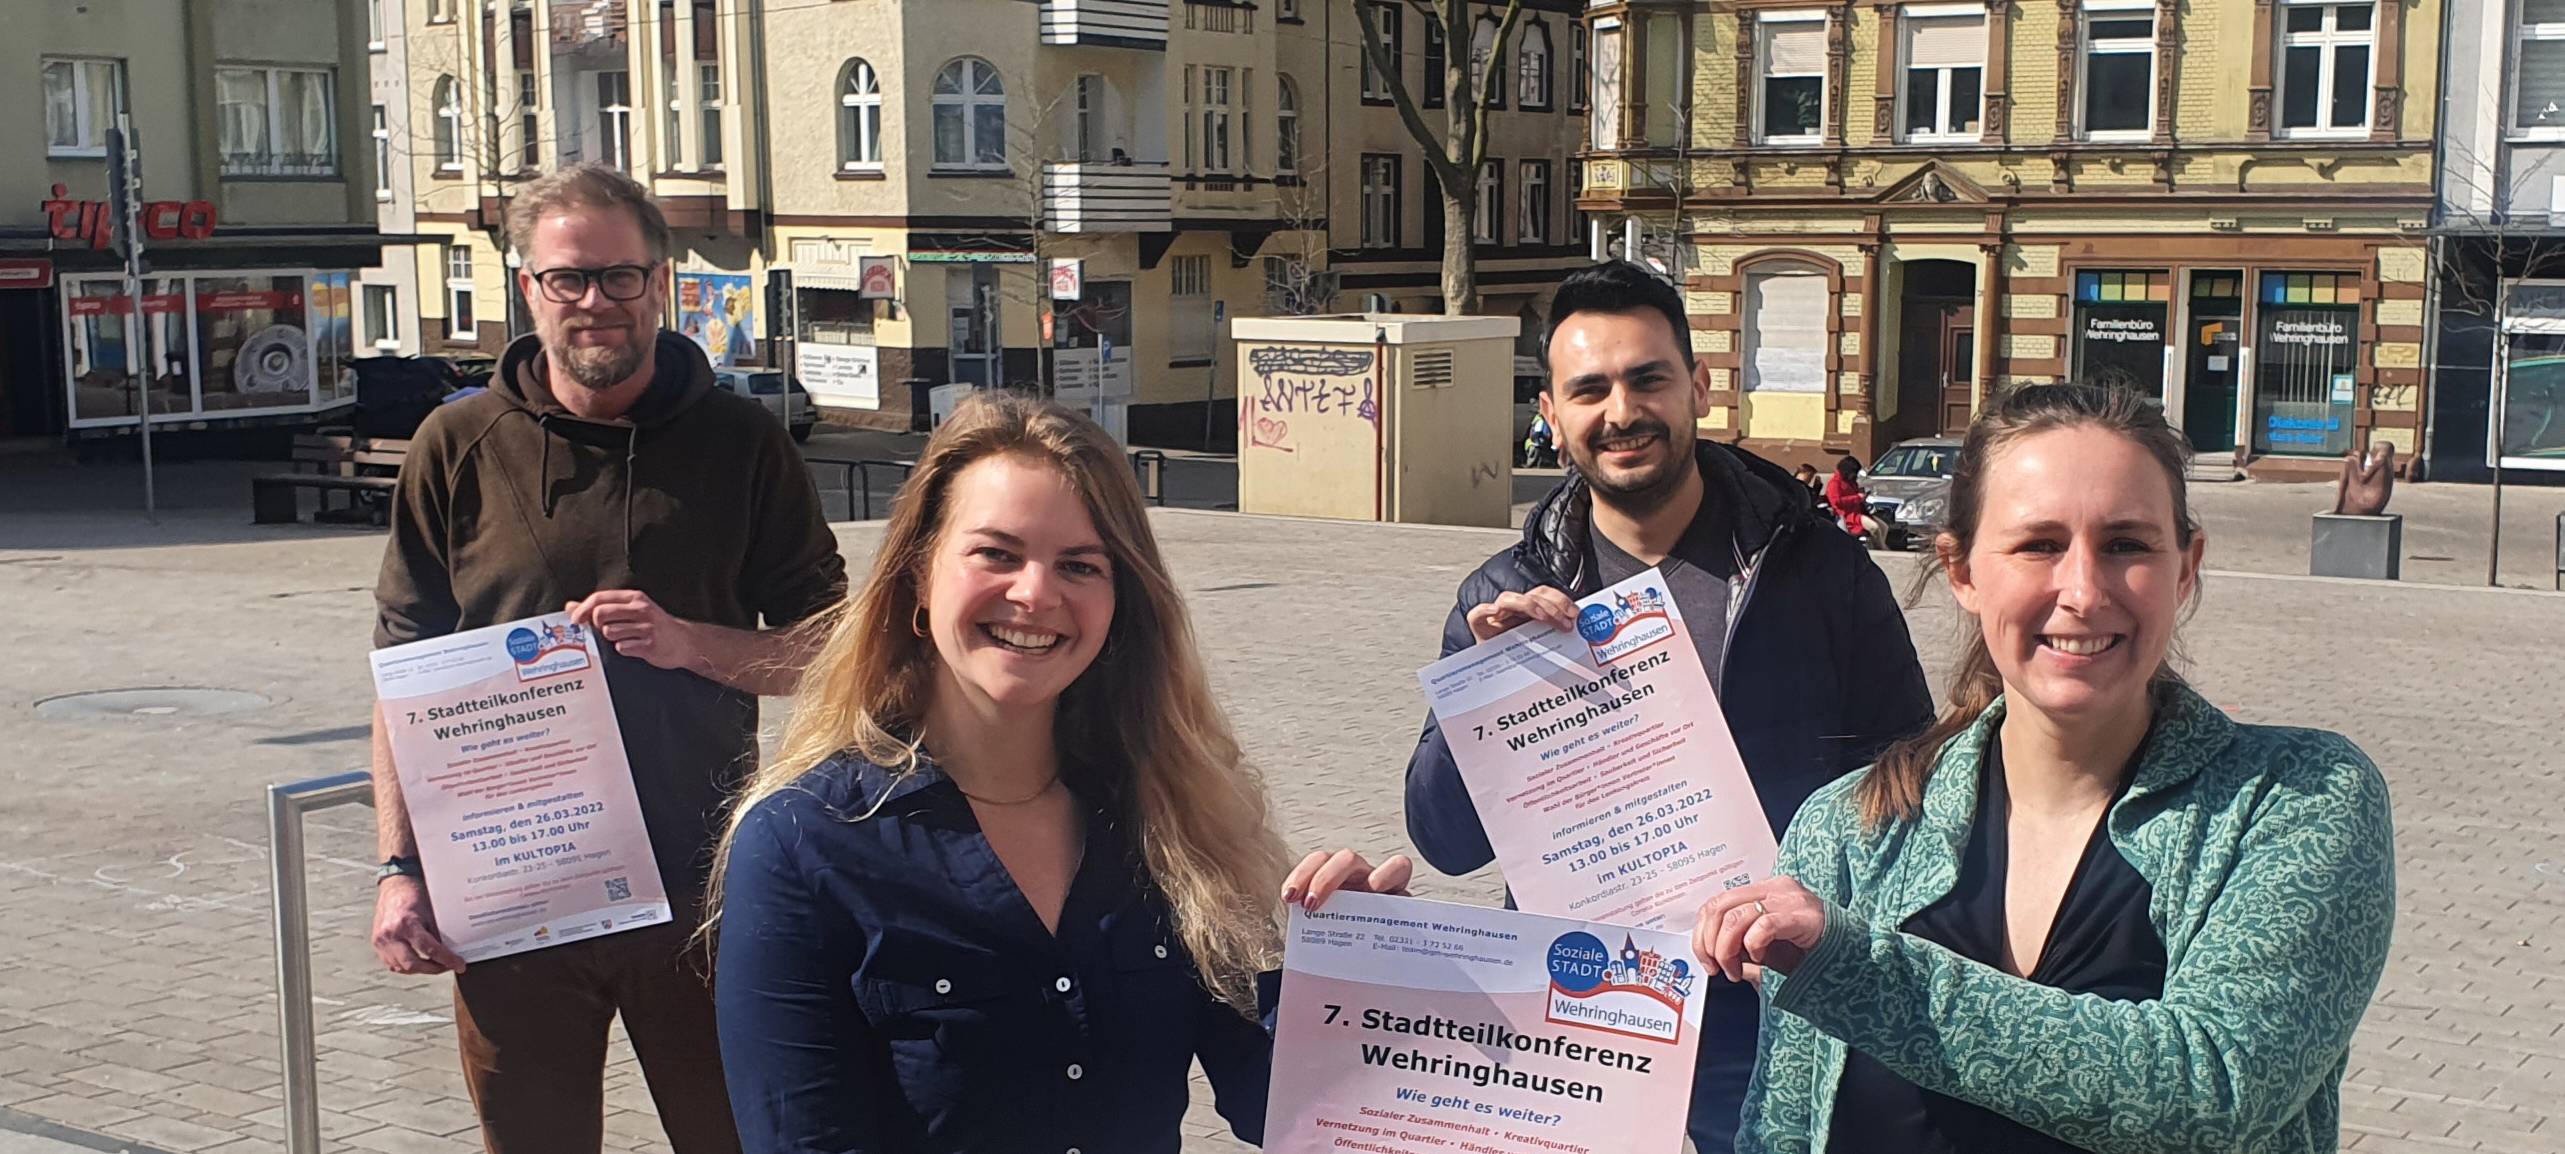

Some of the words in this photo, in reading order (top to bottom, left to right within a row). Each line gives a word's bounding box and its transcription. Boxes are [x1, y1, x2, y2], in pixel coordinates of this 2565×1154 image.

[43, 183, 216, 251] tipco
[2083, 329, 2160, 343] Wehringhausen
[2090, 318, 2154, 330] Familienbüro
[2269, 332, 2349, 346] Wehringhausen
[2275, 320, 2343, 333] Familienbüro
[1582, 616, 1614, 637] STADT
[1596, 625, 1668, 659] Wehringhausen
[510, 642, 540, 656] STADT
[406, 711, 424, 725] 7.
[427, 680, 585, 720] Stadtteilkonferenz
[1472, 723, 1493, 742] 7.
[1496, 651, 1671, 732] Stadtteilkonferenz
[433, 705, 567, 741] Wehringhausen
[1506, 683, 1656, 754] Wehringhausen
[1540, 748, 1560, 762] Wie
[1561, 736, 1586, 755] geht
[1587, 731, 1600, 742] es
[1601, 713, 1640, 737] weiter?
[450, 824, 507, 842] Samstag,
[509, 818, 532, 830] den
[535, 801, 605, 824] 26.03.2022
[1541, 835, 1605, 865] Samstag,
[1608, 823, 1634, 839] den
[1635, 790, 1713, 829] 26.03.2022
[1552, 811, 1612, 840] informieren
[1614, 805, 1622, 816] &
[1624, 781, 1688, 811] mitgestalten
[472, 837, 506, 852] 13.00
[508, 834, 528, 845] bis
[531, 825, 565, 841] 17.00
[567, 821, 591, 834] Uhr
[495, 856, 510, 866] im
[513, 841, 577, 863] KULTOPIA
[1568, 849, 1607, 873] 13.00
[1609, 842, 1631, 857] bis
[1633, 824, 1672, 848] 17.00
[1674, 815, 1700, 832] Uhr
[1568, 883, 1630, 912] Konkordiastr.
[1630, 869, 1659, 887] 23-25
[1666, 854, 1696, 873] 58095
[1697, 843, 1728, 861] Hagen
[1596, 870, 1616, 885] im
[1617, 839, 1689, 877] KULTOPIA
[1303, 910, 1428, 931] Quartiersmanagement
[1431, 924, 1518, 941] Wehringhausen
[1551, 960, 1603, 978] STADT
[1553, 944, 1605, 961] Soziale
[1554, 999, 1673, 1032] Wehringhausen
[1323, 1003, 1350, 1027] 7.
[1360, 1009, 1652, 1073] Stadtteilkonferenz
[1360, 1042, 1604, 1103] Wehringhausen
[1395, 1086, 1428, 1103] Wie
[1430, 1095, 1470, 1110] geht
[1473, 1102, 1493, 1114] es
[1497, 1106, 1562, 1126] weiter?
[1315, 1117, 1380, 1137] Vernetzung
[1382, 1127, 1397, 1138] im
[1399, 1129, 1446, 1145] Quartier
[1359, 1105, 1404, 1121] Sozialer
[1406, 1113, 1492, 1137] Zusammenhalt
[1503, 1130, 1590, 1154] Kreativquartier
